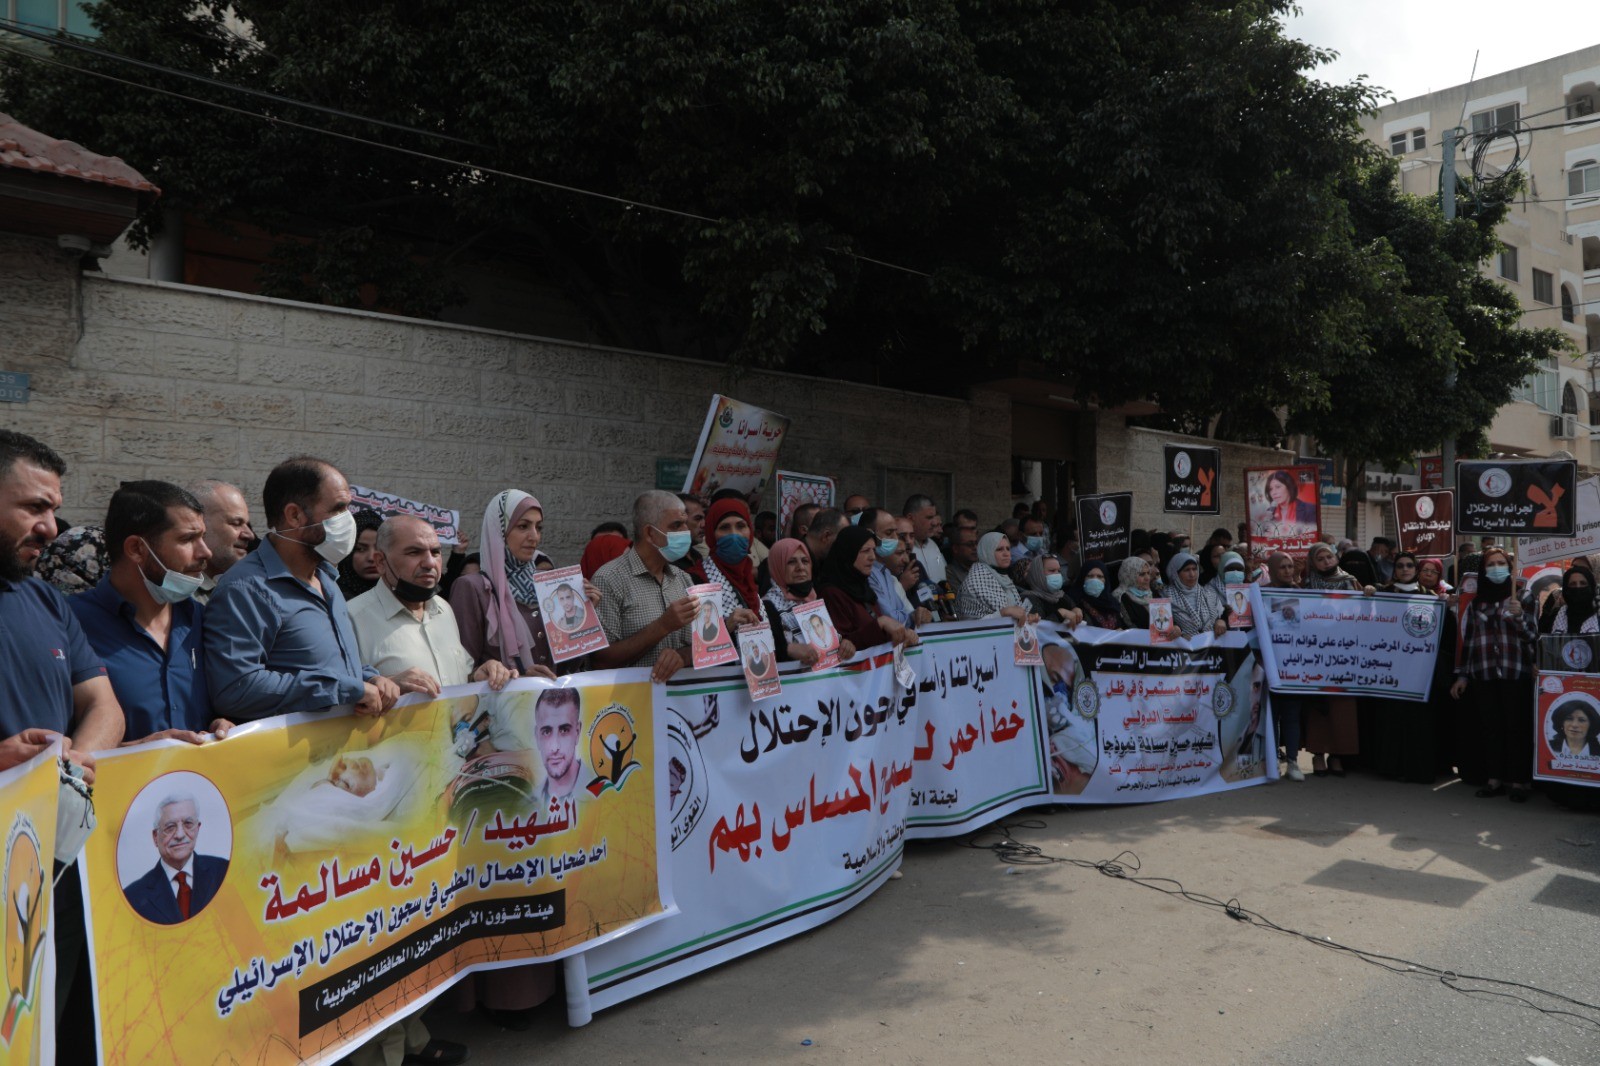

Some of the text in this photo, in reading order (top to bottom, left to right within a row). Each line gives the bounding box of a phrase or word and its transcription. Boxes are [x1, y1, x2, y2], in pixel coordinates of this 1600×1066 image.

[1466, 503, 1533, 516] لجرائم الاحتلال
[1527, 482, 1565, 528] لا
[1511, 518, 1526, 528] ضد
[1528, 543, 1552, 557] must
[1554, 540, 1567, 550] be
[1303, 611, 1334, 621] فلسطين
[1335, 611, 1355, 622] لعمال
[1271, 633, 1293, 647] انتظا
[1295, 634, 1317, 648] قوائم
[1319, 636, 1336, 649] على
[1337, 635, 1359, 650] أحياء
[1369, 638, 1400, 653] المرضى
[1402, 640, 1435, 655] الأسرى
[950, 645, 999, 693] أسيراتنا
[1360, 656, 1393, 670] بسجون
[1301, 671, 1323, 684] حسين
[1357, 673, 1378, 686] لروح
[1106, 679, 1125, 698] ظل
[1126, 680, 1137, 701] في
[1138, 679, 1181, 700] مستمرة
[740, 696, 841, 763] الإحتلال
[990, 700, 1025, 743] خط
[1122, 708, 1198, 730] الصمت الدولي
[942, 700, 986, 771] أحمر
[1138, 735, 1169, 754] مسالمة
[1191, 731, 1216, 754] الشهيد
[1169, 736, 1191, 757] حسين
[772, 758, 877, 852] المساس
[929, 787, 958, 808] لجنة
[484, 796, 577, 849] الشهيد
[709, 801, 762, 875] بهم
[389, 827, 457, 887] حسين
[260, 857, 381, 921] مسالمة
[485, 904, 521, 926] شؤون
[525, 904, 554, 920] هيئة
[218, 838, 607, 1015] أحد ضحايا الإهمال الطبي في سجون الإحتلال الإسرائيلي
[322, 973, 366, 1008] الجنوبية
